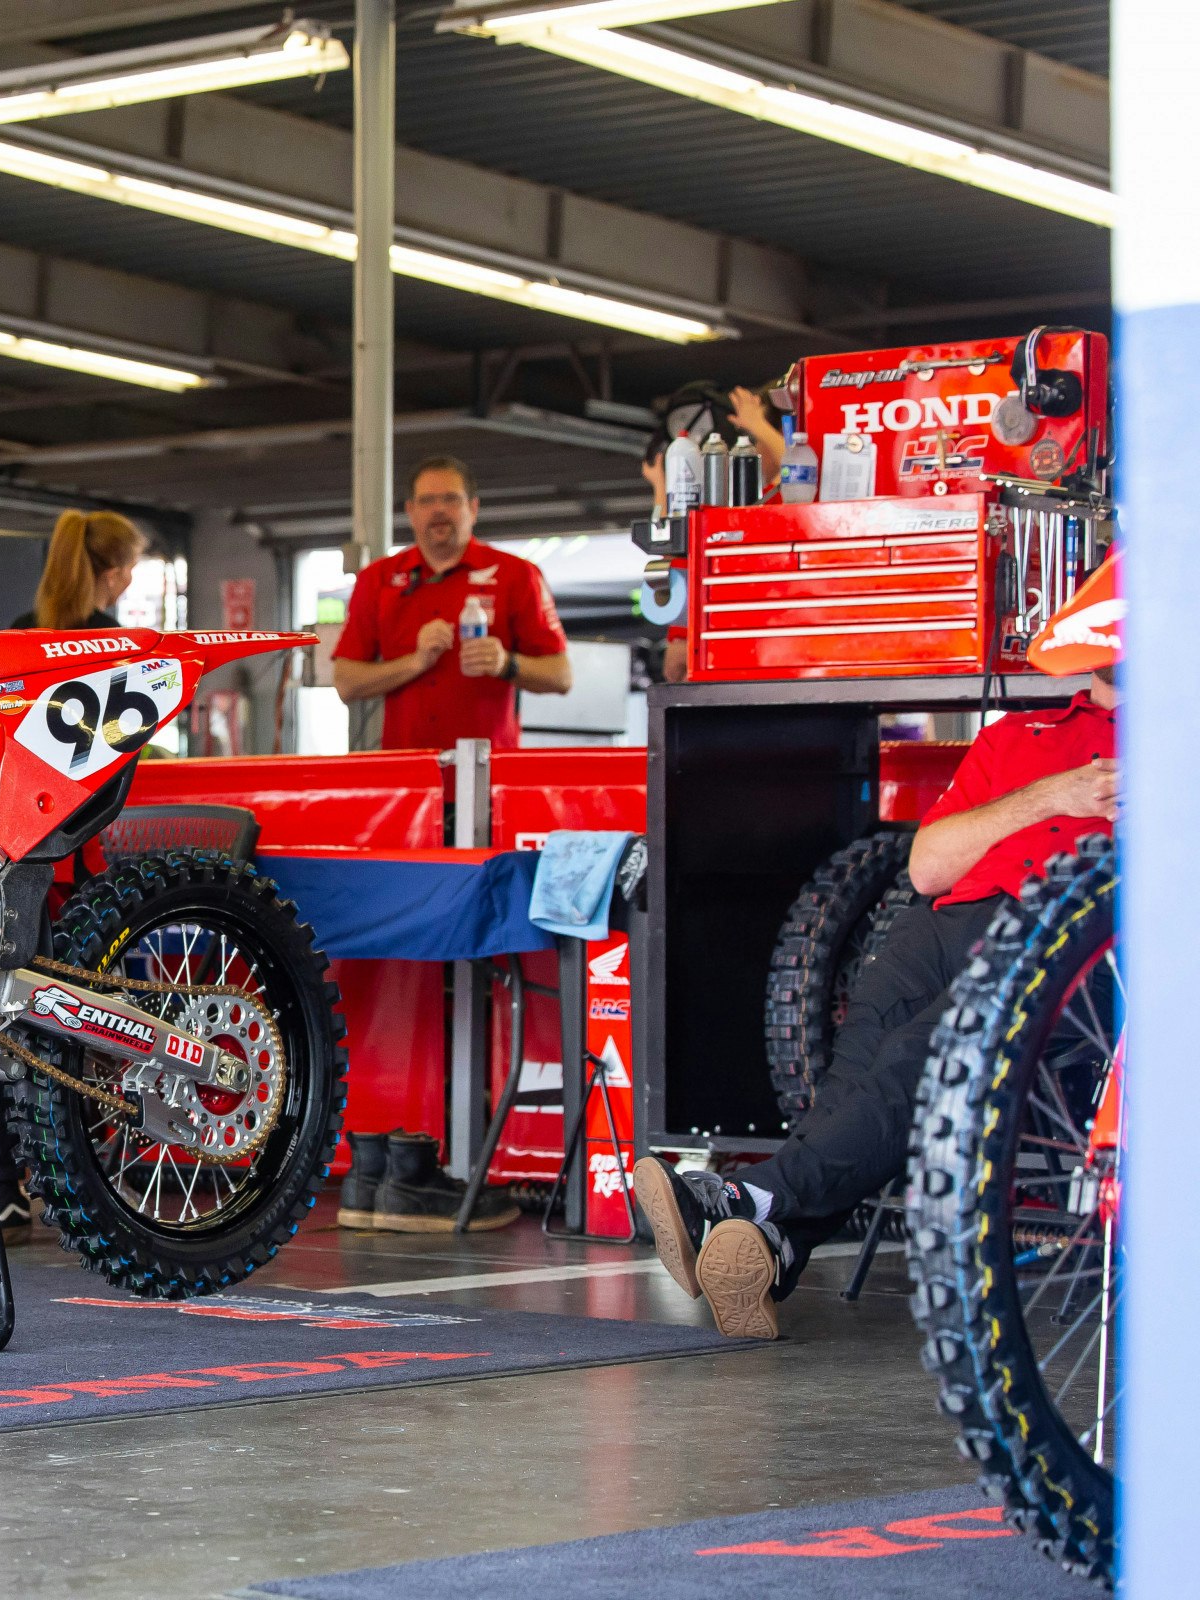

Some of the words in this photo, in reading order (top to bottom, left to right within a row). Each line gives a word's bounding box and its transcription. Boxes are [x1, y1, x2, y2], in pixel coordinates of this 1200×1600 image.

[840, 391, 1040, 434] HOND
[41, 636, 141, 658] HONDA
[141, 660, 171, 674] AMA
[45, 670, 159, 774] 96
[34, 986, 156, 1043] RENTHAL
[84, 1024, 150, 1051] CHAINWHEELS
